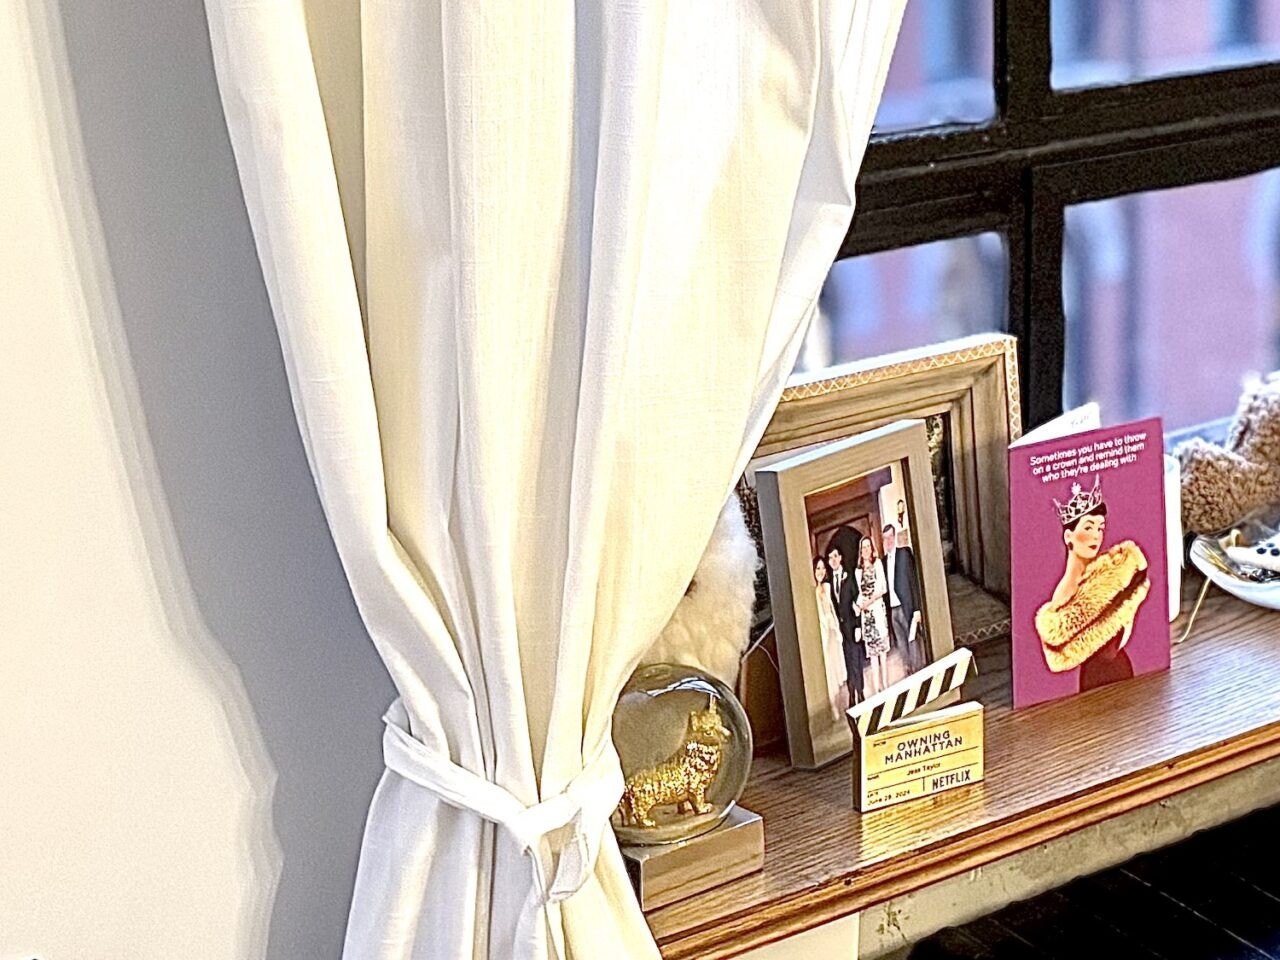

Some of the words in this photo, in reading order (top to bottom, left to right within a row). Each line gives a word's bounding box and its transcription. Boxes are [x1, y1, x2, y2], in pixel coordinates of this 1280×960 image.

[1030, 449, 1076, 466] Sometimes
[1078, 445, 1093, 456] you
[1094, 440, 1114, 451] have
[1114, 437, 1123, 447] to
[1124, 433, 1147, 442] throw
[1032, 466, 1045, 475] on
[1045, 464, 1052, 472] a
[1052, 458, 1078, 471] crown
[1078, 453, 1095, 464] and
[1095, 448, 1124, 460] remind
[1124, 442, 1145, 453] them
[1042, 471, 1060, 483] who
[1061, 464, 1089, 478] they're
[1090, 457, 1119, 471] dealing
[1120, 453, 1137, 464] with
[885, 736, 963, 765] MANHATTAN
[897, 730, 950, 752] OWNING
[932, 769, 971, 790] NETFLIX
